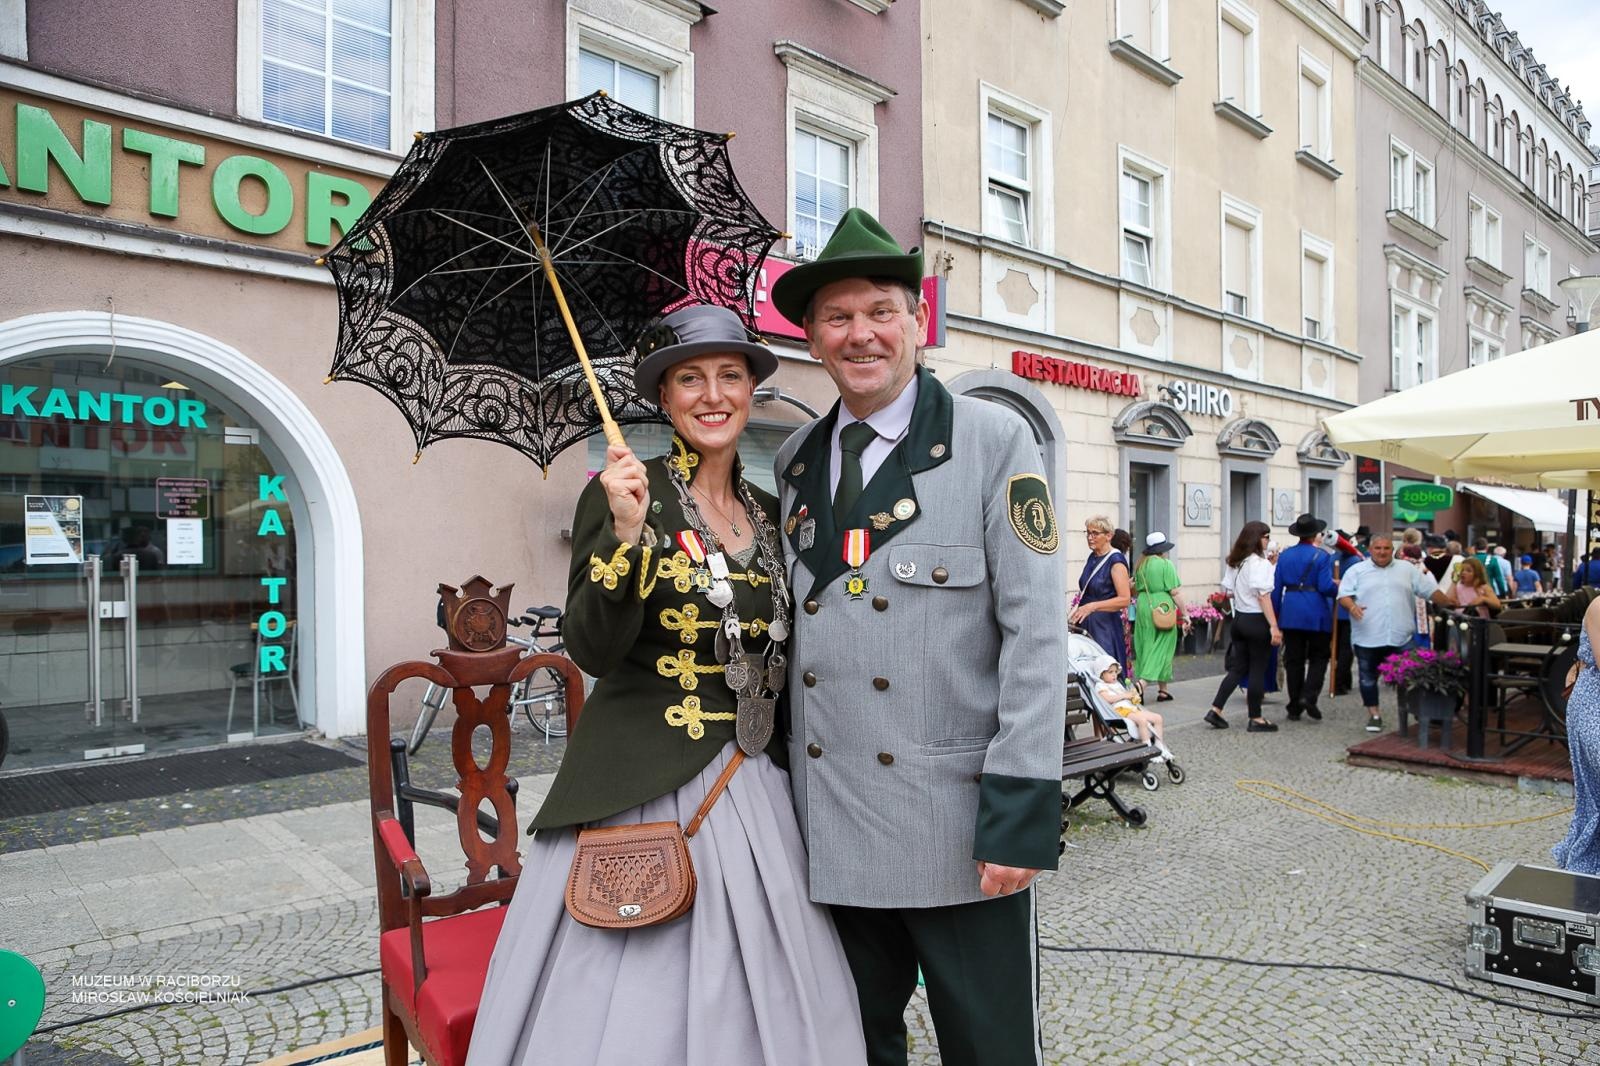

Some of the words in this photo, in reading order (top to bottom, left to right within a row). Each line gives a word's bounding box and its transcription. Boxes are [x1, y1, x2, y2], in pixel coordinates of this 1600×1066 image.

[0, 103, 374, 248] NTOR
[1012, 350, 1141, 398] RESTAURACJA
[1, 384, 208, 429] KANTOR
[1173, 380, 1233, 417] SHIRO
[1403, 489, 1446, 503] żabka
